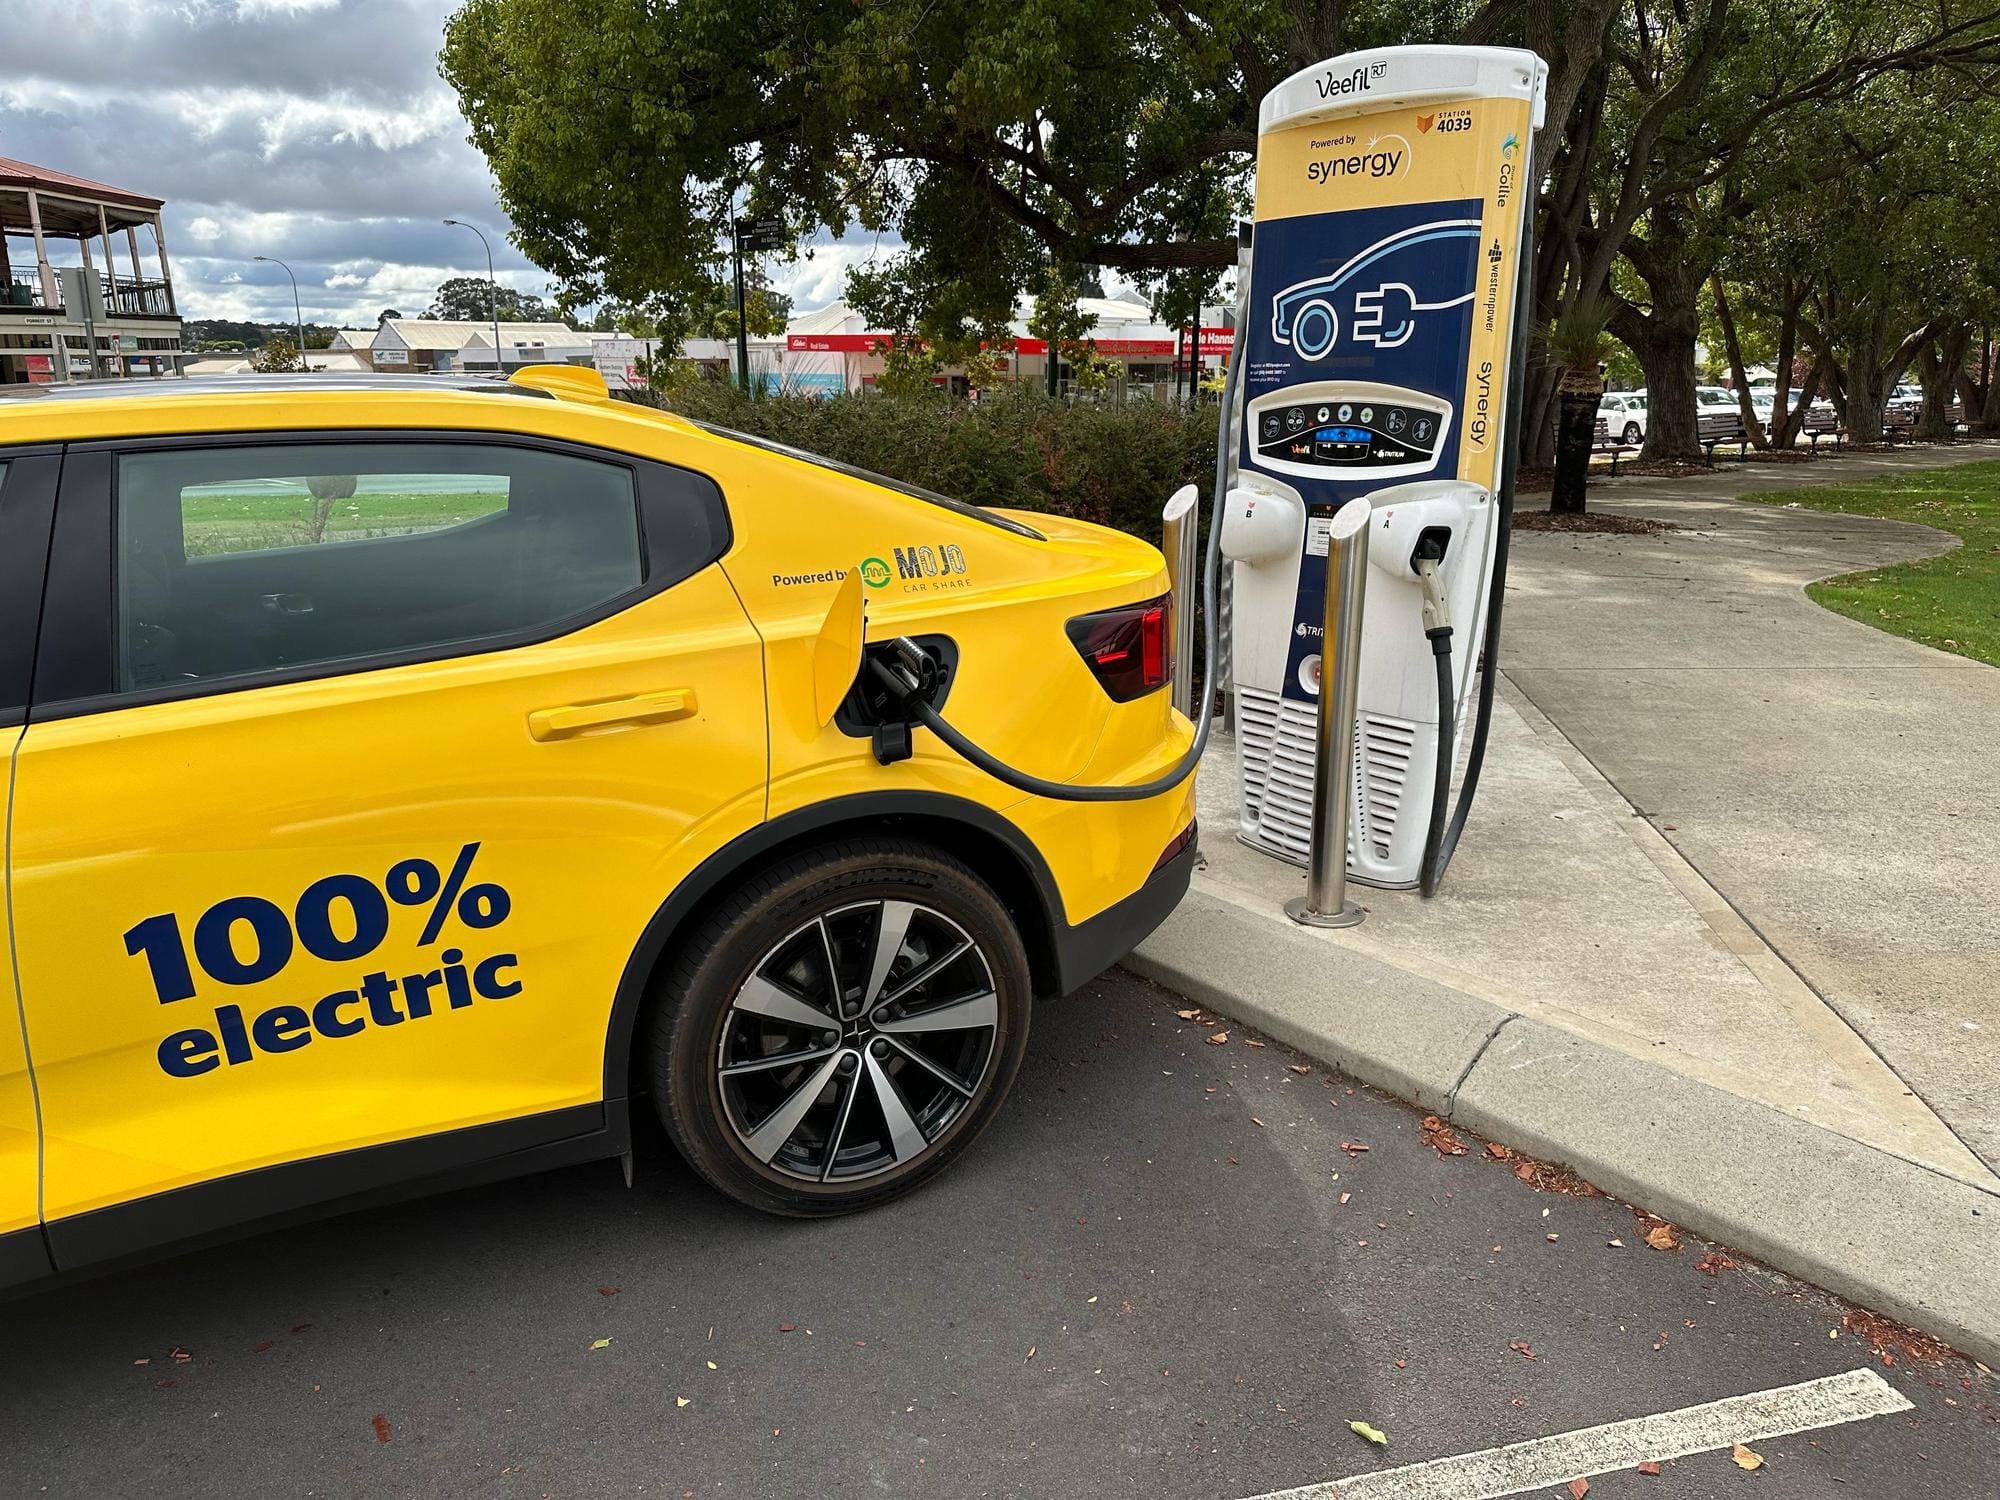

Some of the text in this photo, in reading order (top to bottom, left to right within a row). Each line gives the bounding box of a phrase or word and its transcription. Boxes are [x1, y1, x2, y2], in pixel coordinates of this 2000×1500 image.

[1315, 64, 1386, 98] Veefil RT
[1438, 110, 1471, 119] STATION
[1437, 117, 1472, 132] 4039
[1310, 136, 1356, 149] Powered by
[1307, 150, 1402, 184] synergy
[1497, 163, 1511, 208] Collie
[1483, 264, 1499, 333] westernpower
[1183, 332, 1206, 344] Joie
[1471, 361, 1492, 445] synergy
[1245, 509, 1253, 518] B
[1382, 519, 1390, 529] A
[893, 544, 966, 580] MOJO
[772, 570, 834, 587] Powered
[903, 579, 973, 593] CAR SHARE
[1307, 625, 1324, 637] TRIT
[123, 842, 511, 1004] 100%
[157, 948, 523, 1078] electric
